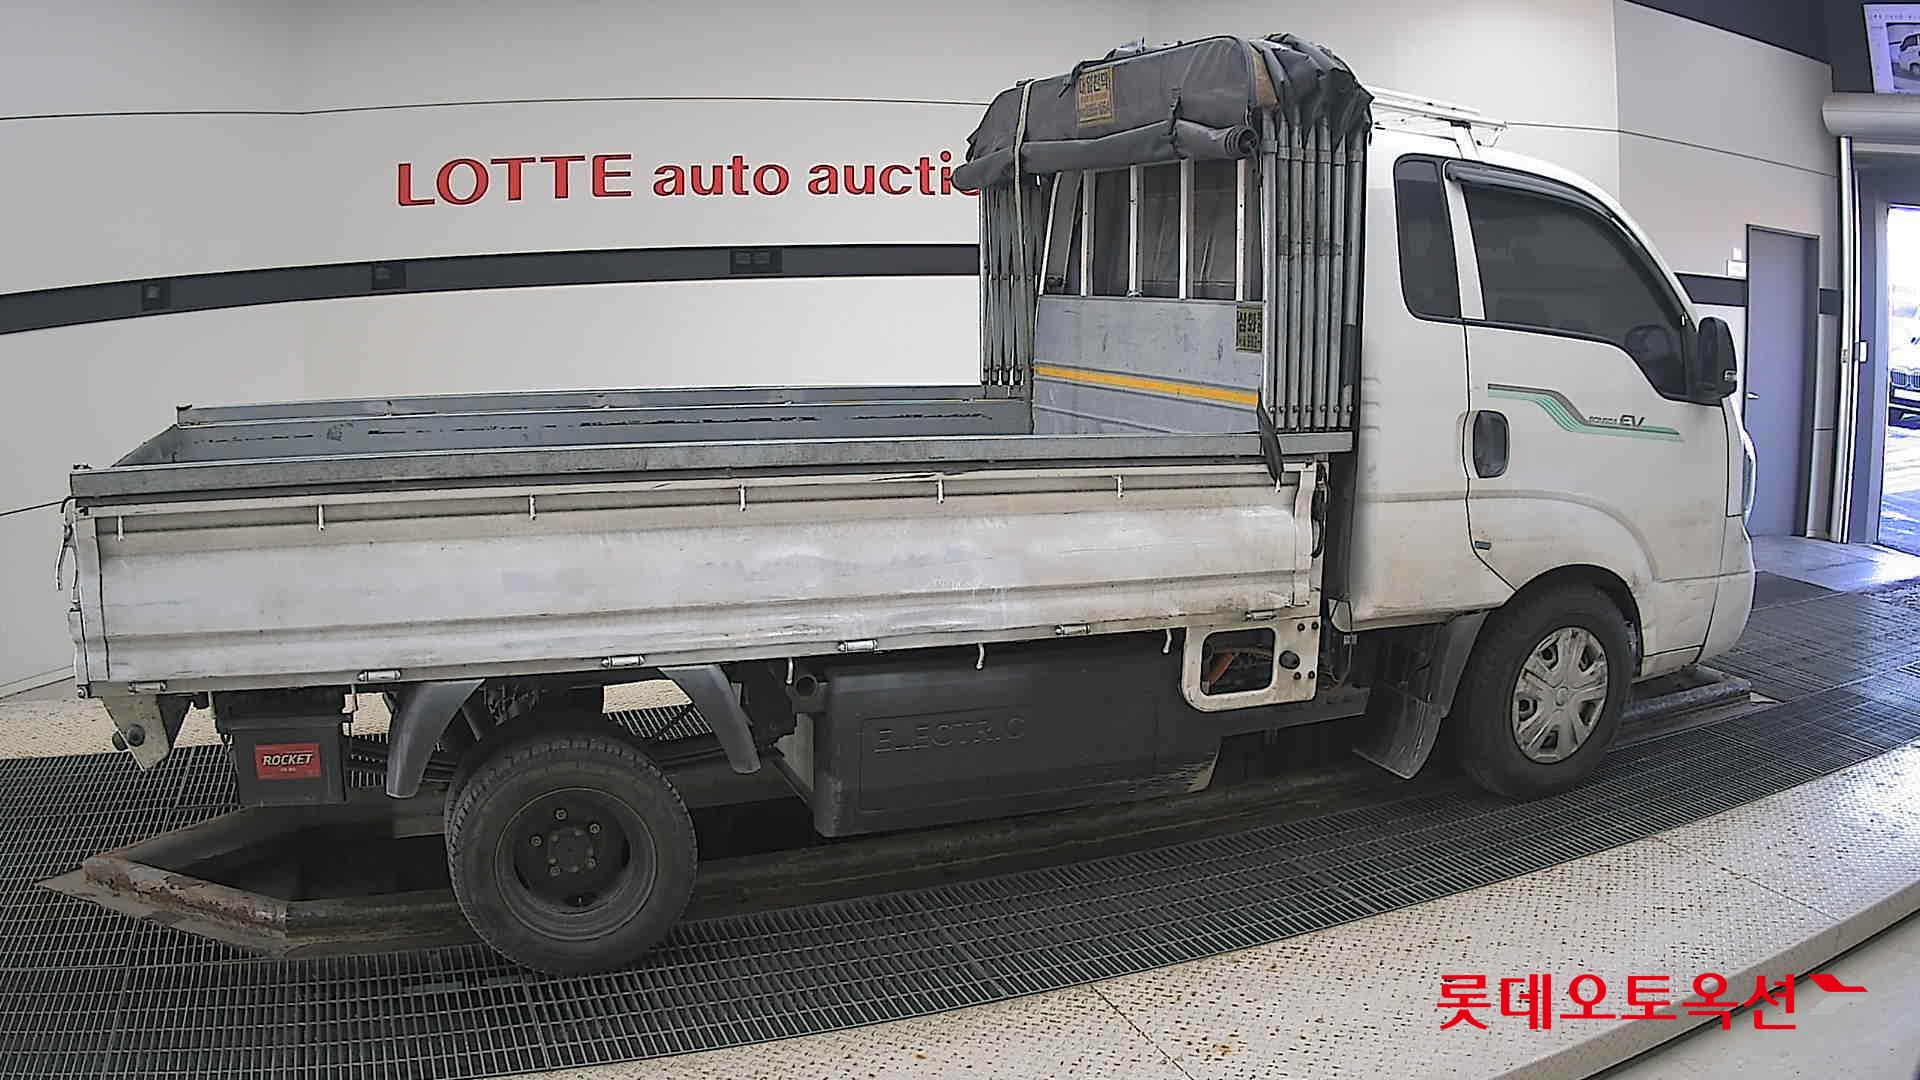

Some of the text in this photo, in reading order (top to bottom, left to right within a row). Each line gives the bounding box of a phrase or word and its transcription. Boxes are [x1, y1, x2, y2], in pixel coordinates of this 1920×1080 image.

[397, 151, 980, 206] LOTTE auto aucti
[1619, 413, 1645, 427] EV
[262, 752, 313, 766] ROCKET
